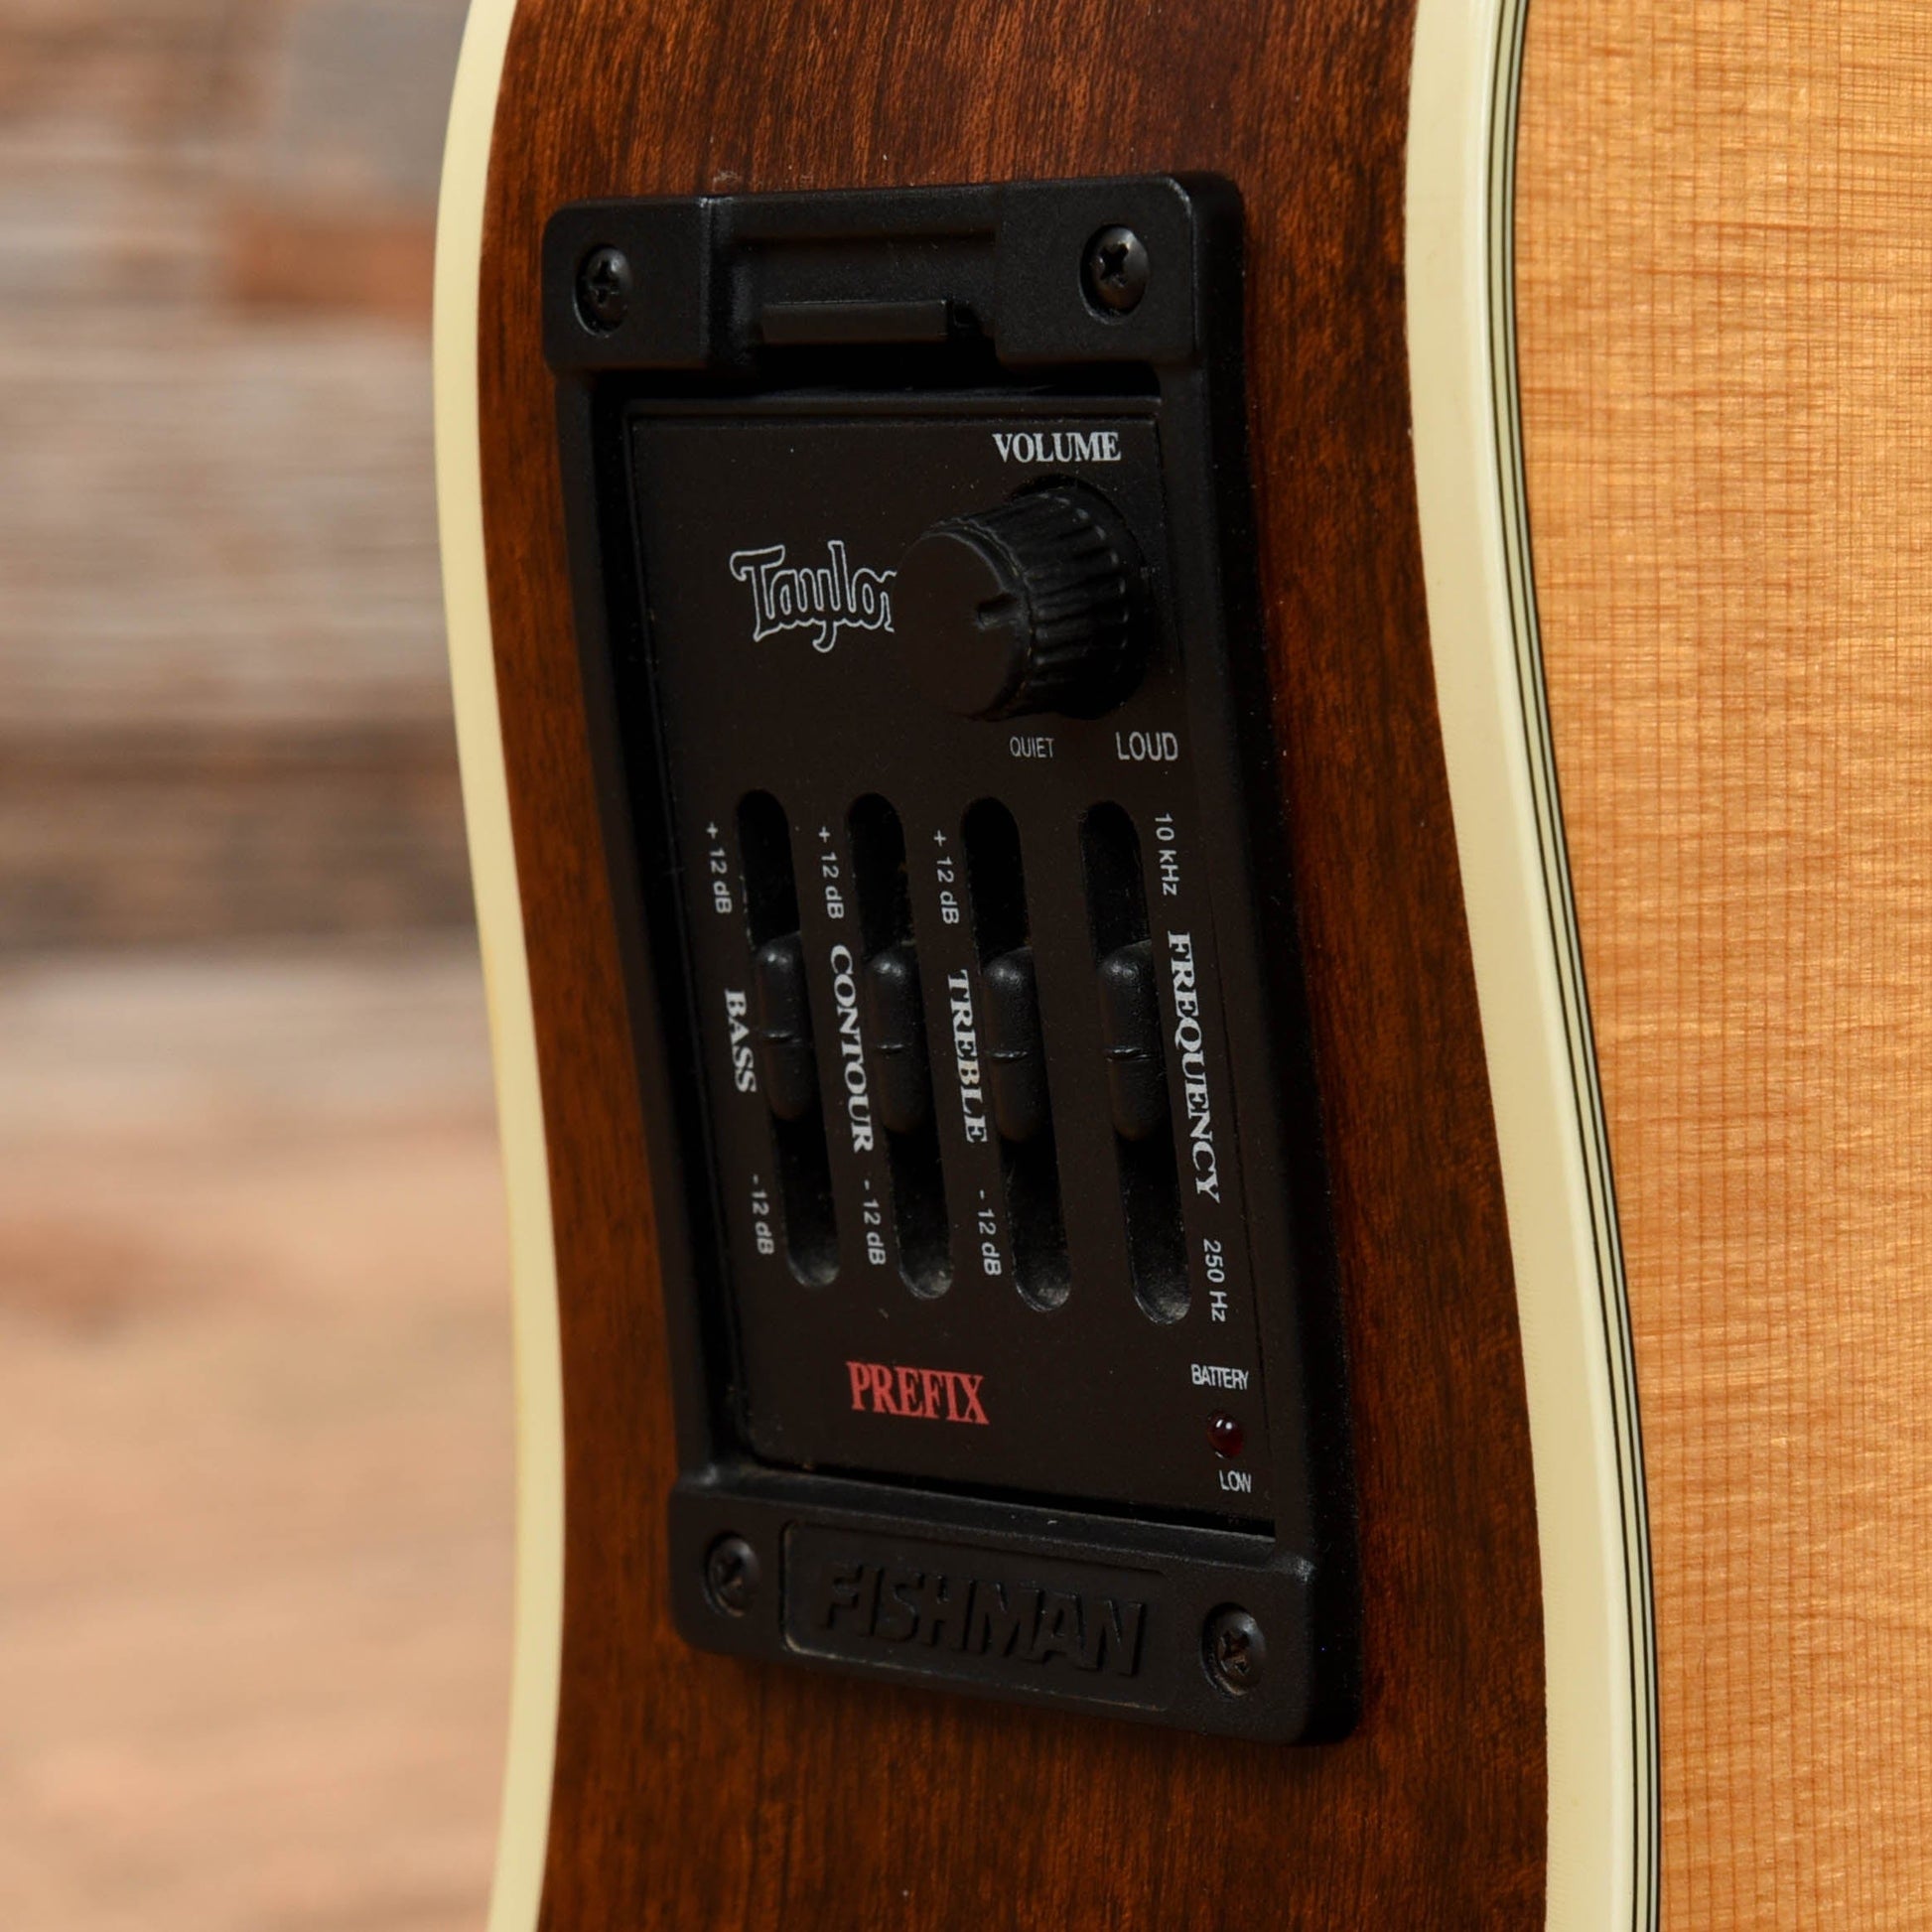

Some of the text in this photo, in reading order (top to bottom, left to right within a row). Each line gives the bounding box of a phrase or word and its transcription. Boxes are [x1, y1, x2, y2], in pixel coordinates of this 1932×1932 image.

[992, 431, 1122, 464] VOLUME
[1010, 736, 1054, 759] QUIET
[1115, 731, 1179, 762] LOUD
[1155, 812, 1175, 843] 10
[713, 880, 733, 914] dB
[824, 886, 845, 919] dB
[939, 891, 960, 924] dB
[724, 989, 758, 1093] BASS
[830, 944, 875, 1154] CONTOUR
[947, 969, 988, 1144] TREBLE
[1167, 930, 1221, 1204] FREQUENCY
[755, 1221, 775, 1255] dB
[866, 1231, 887, 1266] dB
[981, 1241, 1003, 1277] dB
[1202, 1237, 1226, 1284] 250
[845, 1359, 990, 1426] PREFIX
[1190, 1363, 1250, 1391] BATTERY
[1218, 1469, 1253, 1493] LOW
[822, 1561, 1147, 1676] FISHMAN
